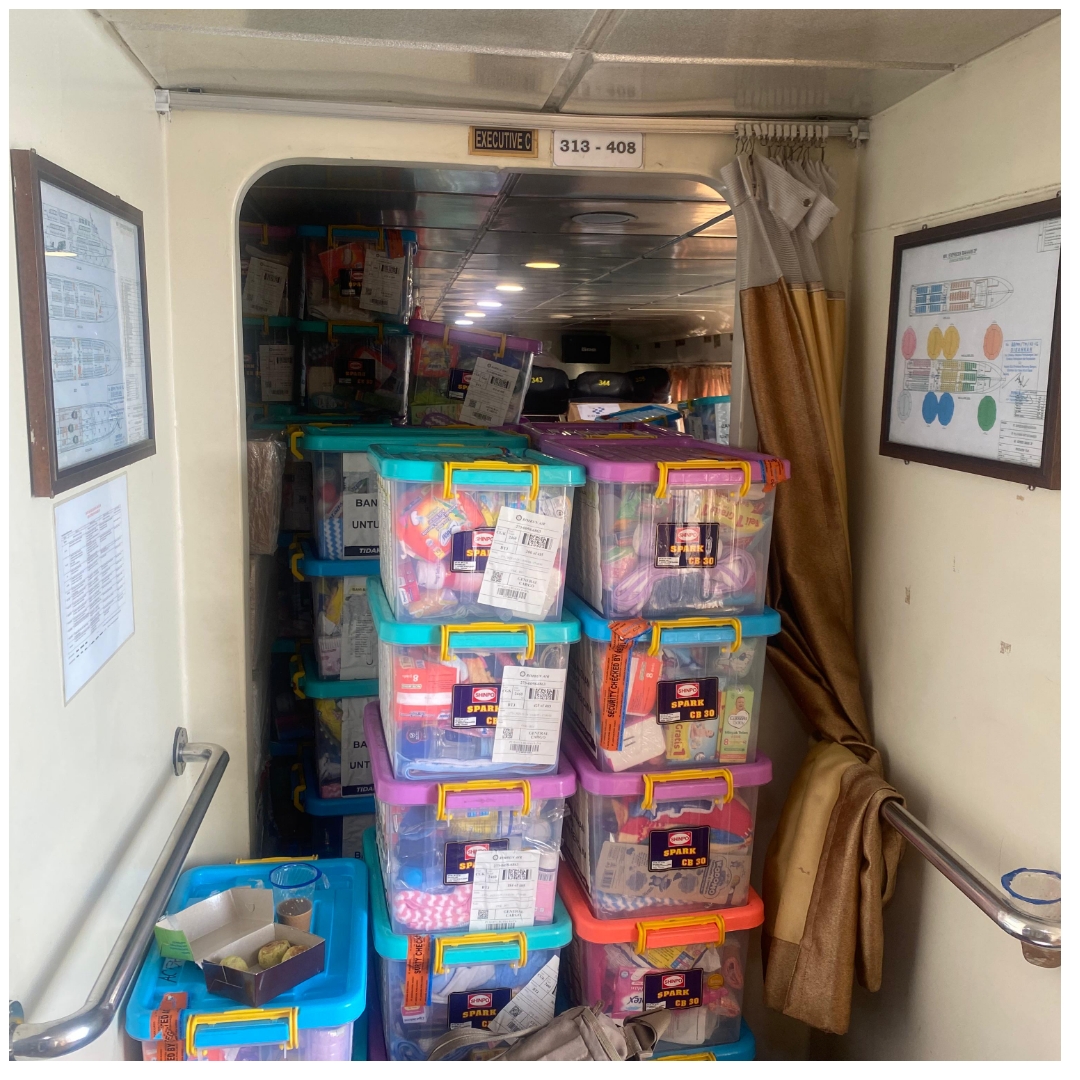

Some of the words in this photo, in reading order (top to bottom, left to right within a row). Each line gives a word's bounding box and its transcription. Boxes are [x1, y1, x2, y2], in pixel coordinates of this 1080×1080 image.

[475, 130, 522, 149] EXECUTIVE
[525, 132, 531, 149] C
[560, 139, 590, 153] 313
[606, 141, 636, 154] 408
[531, 376, 544, 384] 343
[598, 379, 610, 387] 344
[670, 544, 704, 553] SPARK
[688, 557, 700, 565] CB
[702, 557, 714, 565] 30
[612, 653, 621, 662] BY
[610, 663, 621, 689] CHECKED
[677, 687, 698, 696] SHINPO
[607, 691, 618, 718] SECURITY
[671, 699, 704, 709] SPARK
[689, 711, 702, 719] CB
[703, 709, 715, 718] 30
[673, 723, 683, 749] Gratis
[670, 835, 690, 843] SHINPO
[663, 847, 696, 857] SPARK
[695, 857, 706, 866] 30
[657, 989, 689, 999] SPARK
[470, 996, 490, 1004] SHINPO
[675, 999, 687, 1007] CB
[689, 997, 699, 1006] 30
[462, 1009, 497, 1018] SPARK
